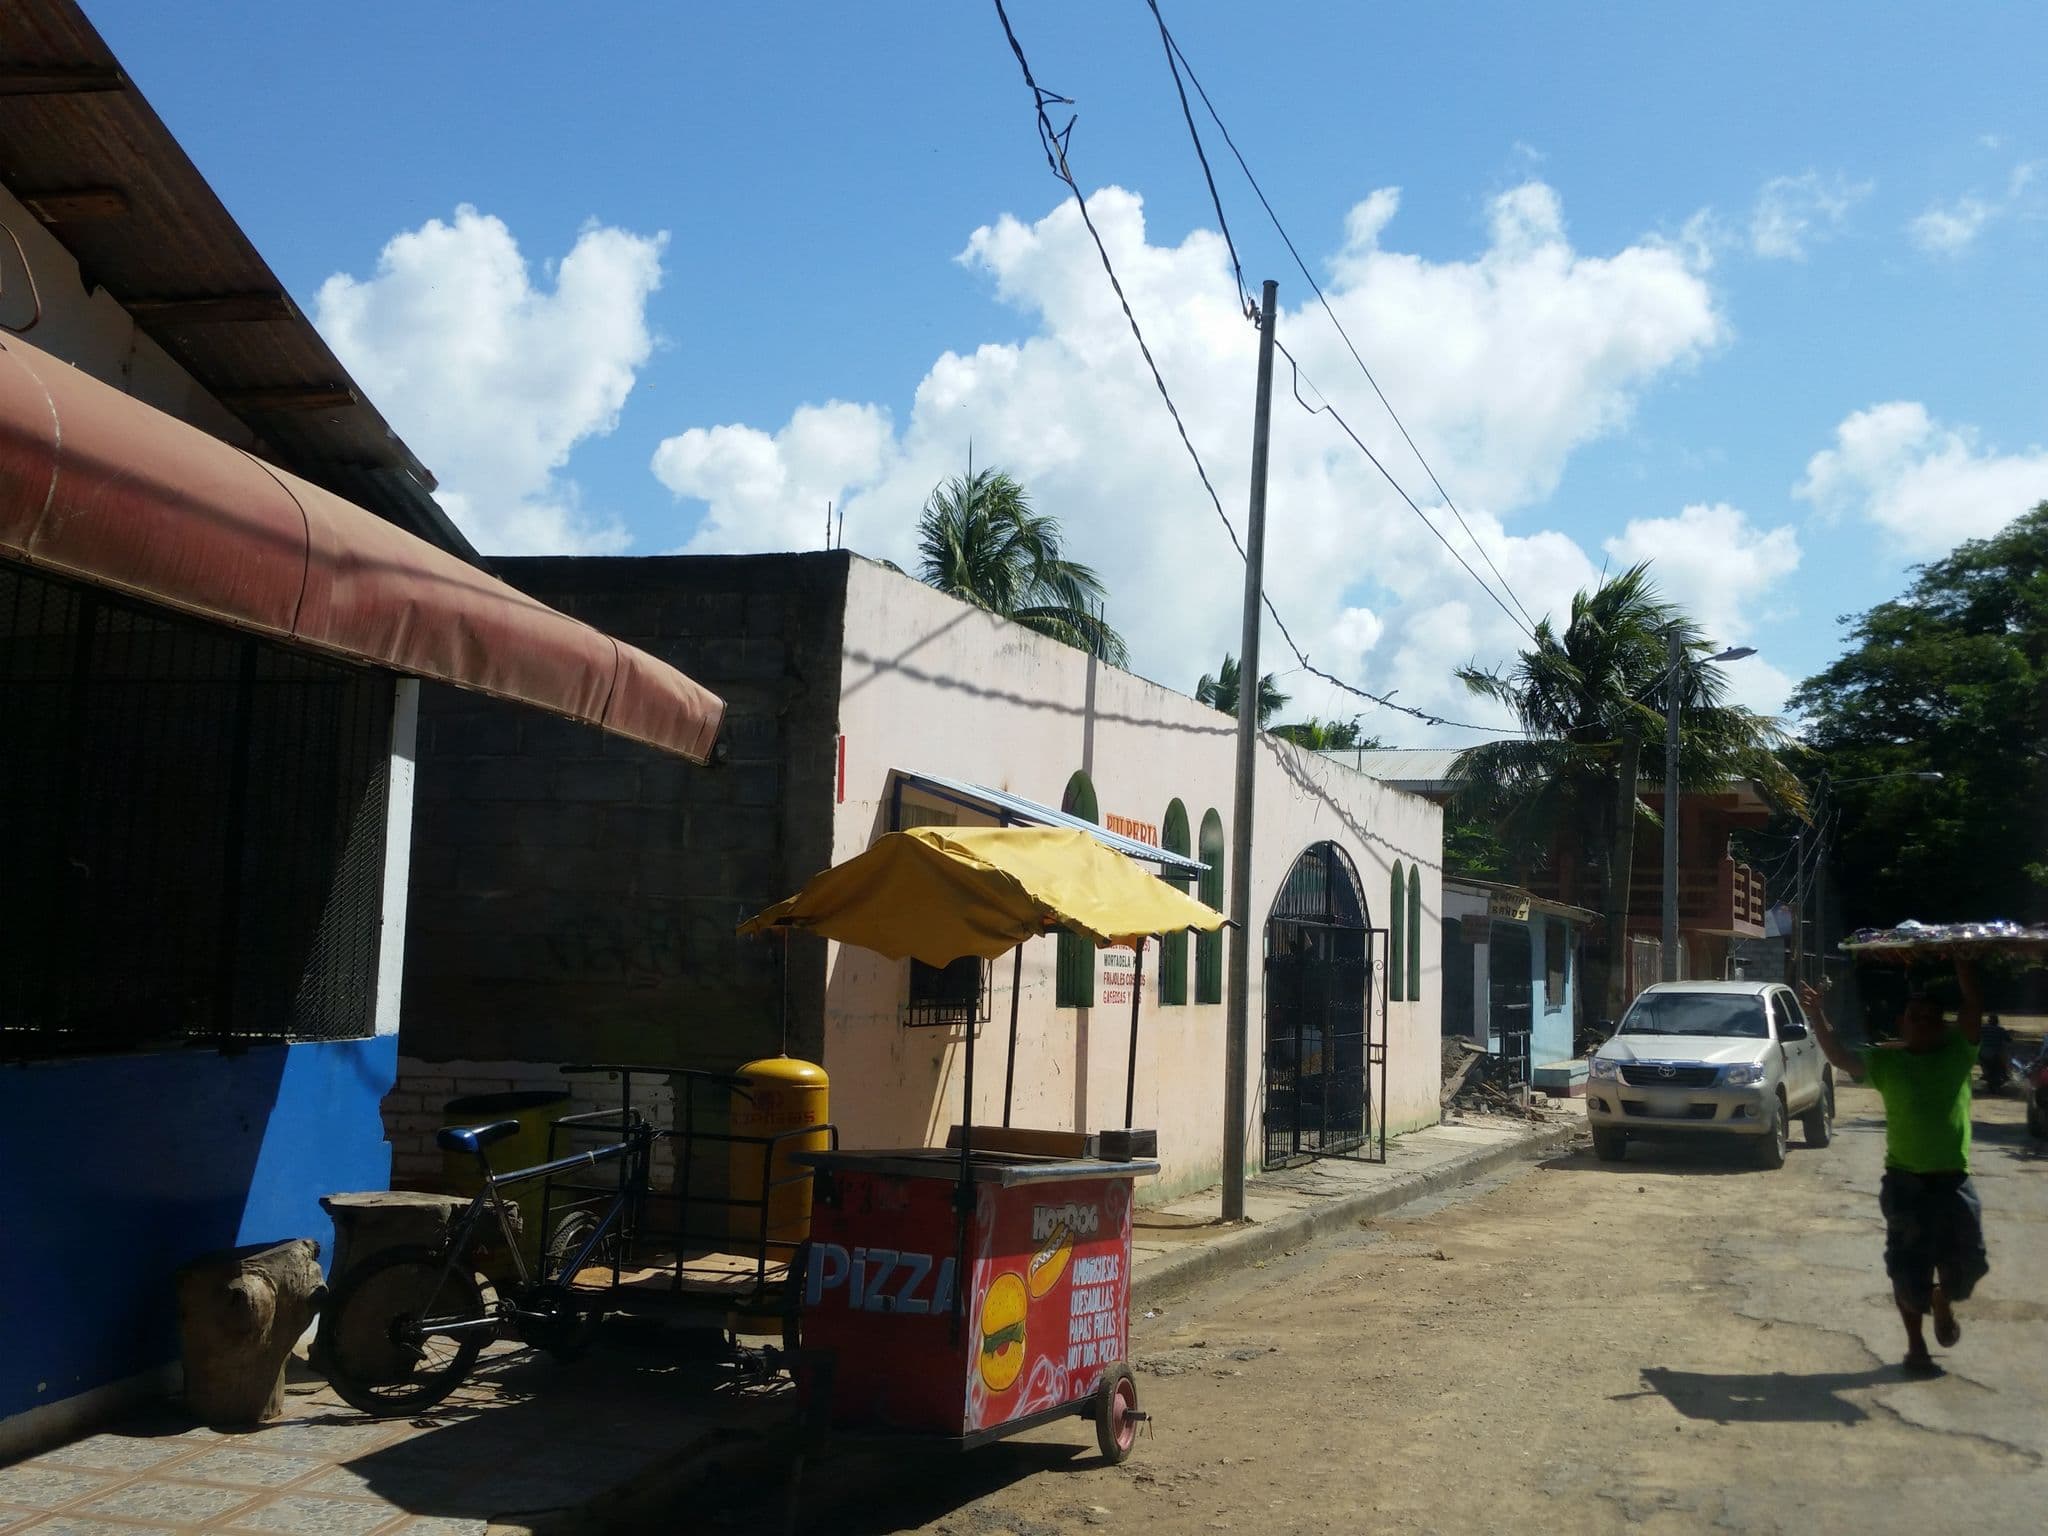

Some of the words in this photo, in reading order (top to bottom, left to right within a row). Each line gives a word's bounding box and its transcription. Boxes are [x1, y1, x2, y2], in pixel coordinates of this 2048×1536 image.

[1103, 953, 1131, 968] MORTADELA
[1068, 1315, 1093, 1344] PAPAS
[1094, 1310, 1117, 1339] FRITAS
[1066, 1343, 1083, 1372] HOT
